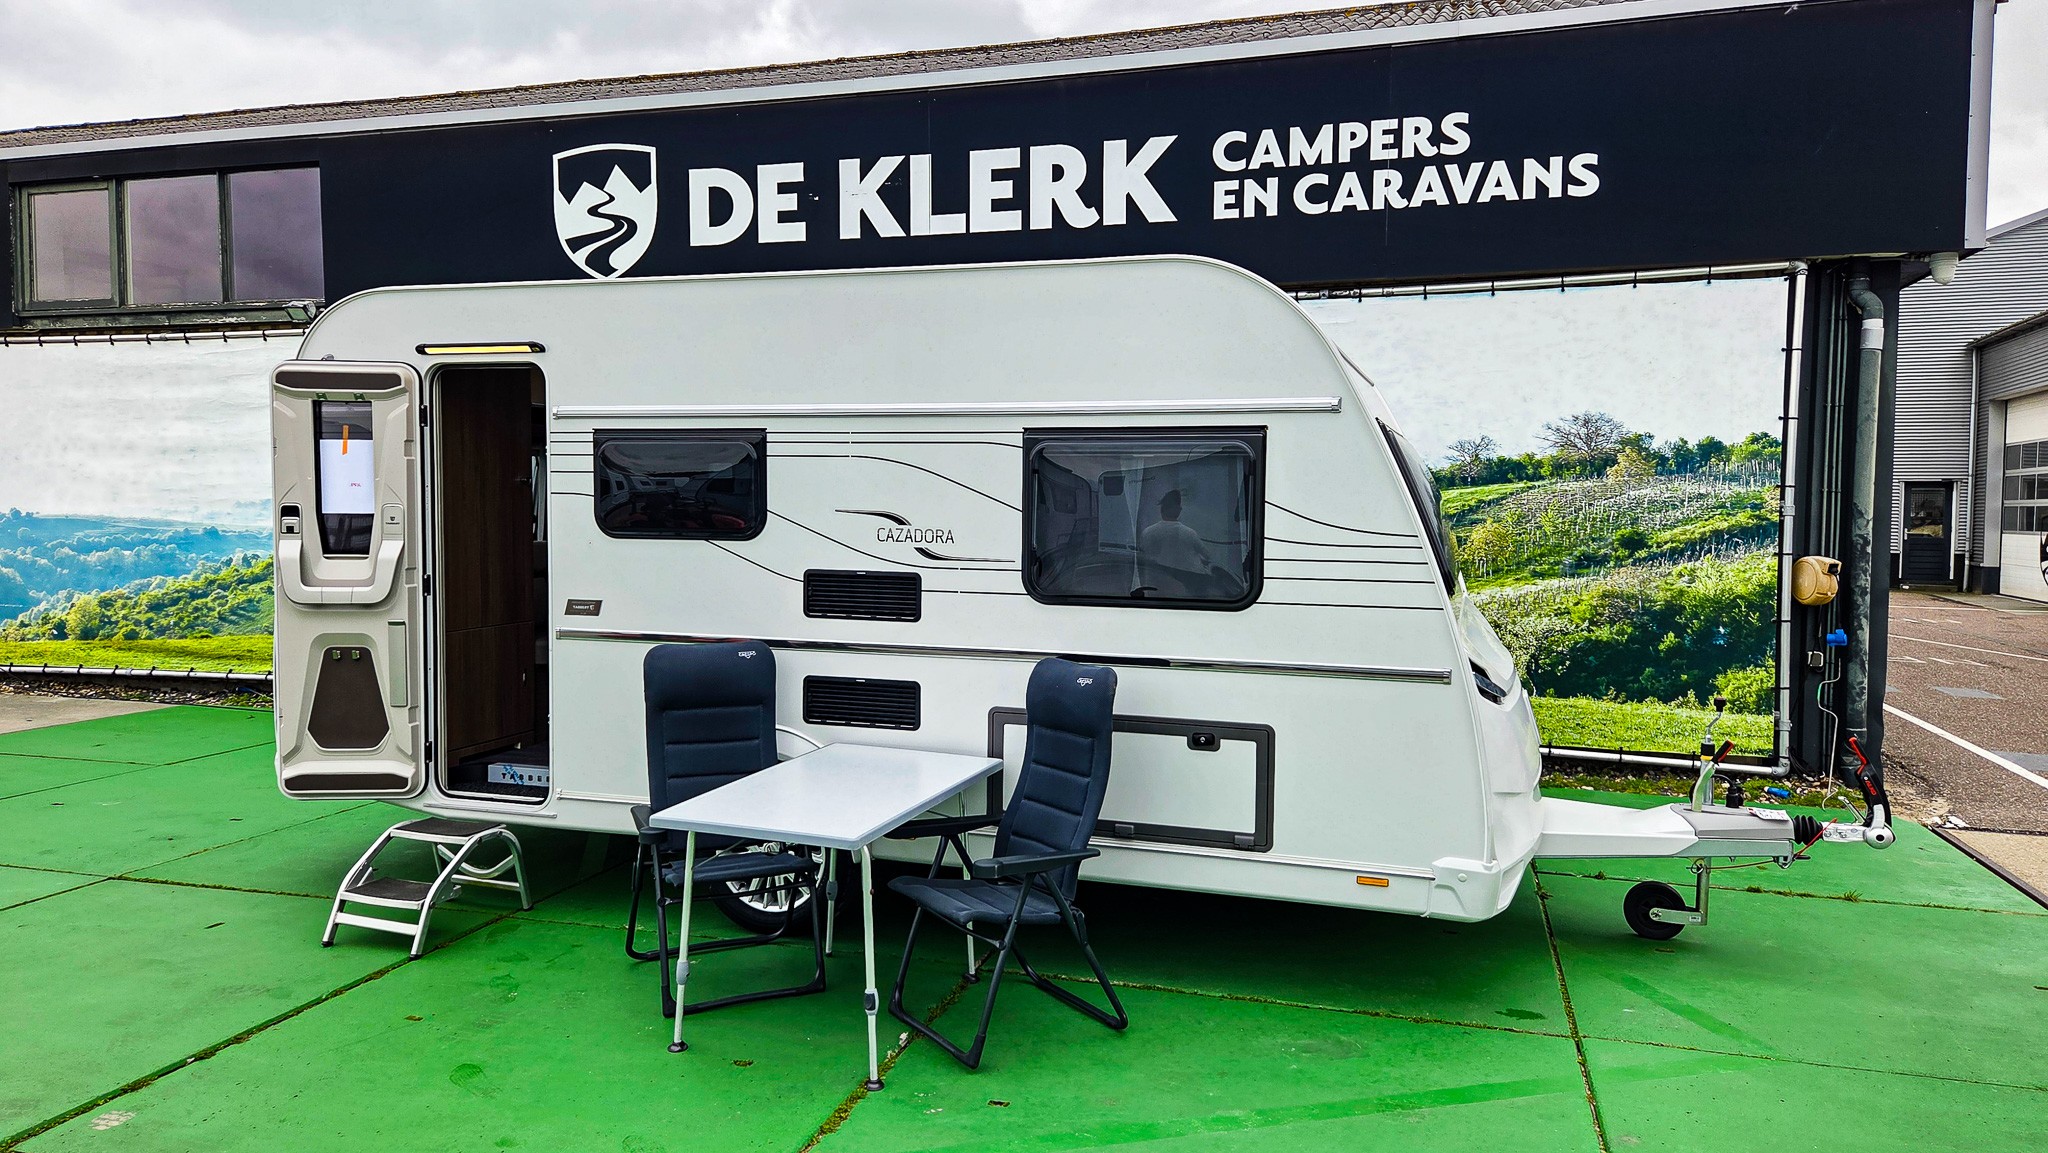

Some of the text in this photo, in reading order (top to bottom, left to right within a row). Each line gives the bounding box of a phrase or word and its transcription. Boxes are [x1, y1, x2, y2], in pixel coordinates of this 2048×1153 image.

[1212, 112, 1471, 172] CAMPERS
[689, 135, 1178, 246] DE KLERK
[1213, 153, 1600, 220] EN CARAVANS
[877, 527, 955, 544] CAZADORA
